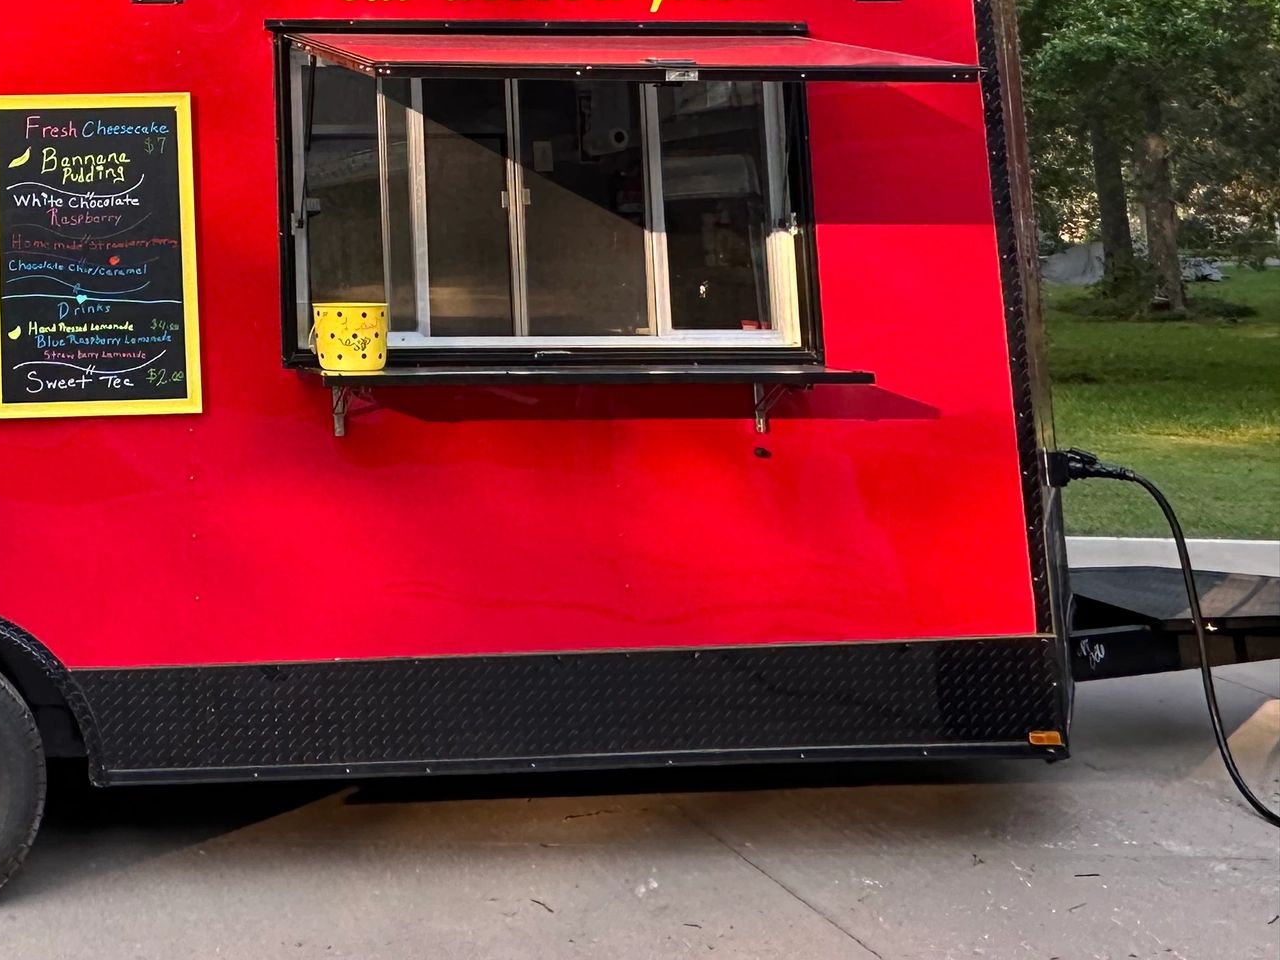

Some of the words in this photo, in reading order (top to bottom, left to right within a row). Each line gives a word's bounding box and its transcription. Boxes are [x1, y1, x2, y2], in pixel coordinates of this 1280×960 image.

[25, 115, 78, 139] Fresh
[81, 119, 170, 138] Cheesecake
[144, 136, 167, 155] $7
[62, 164, 125, 185] Pudding
[13, 192, 64, 208] White
[69, 194, 140, 209] Chocolate
[47, 207, 122, 227] Raspberry
[8, 259, 64, 272] Chocolate
[57, 302, 111, 320] Drinks
[28, 320, 57, 336] Hand
[59, 322, 88, 334] Pressed
[90, 320, 134, 332] Lemonade
[36, 335, 66, 349] Blue
[67, 334, 120, 347] Raspberry
[124, 331, 172, 344] Lemonade
[101, 350, 146, 360] Lemonade
[26, 371, 93, 394] Sweet
[99, 375, 135, 389] Tea
